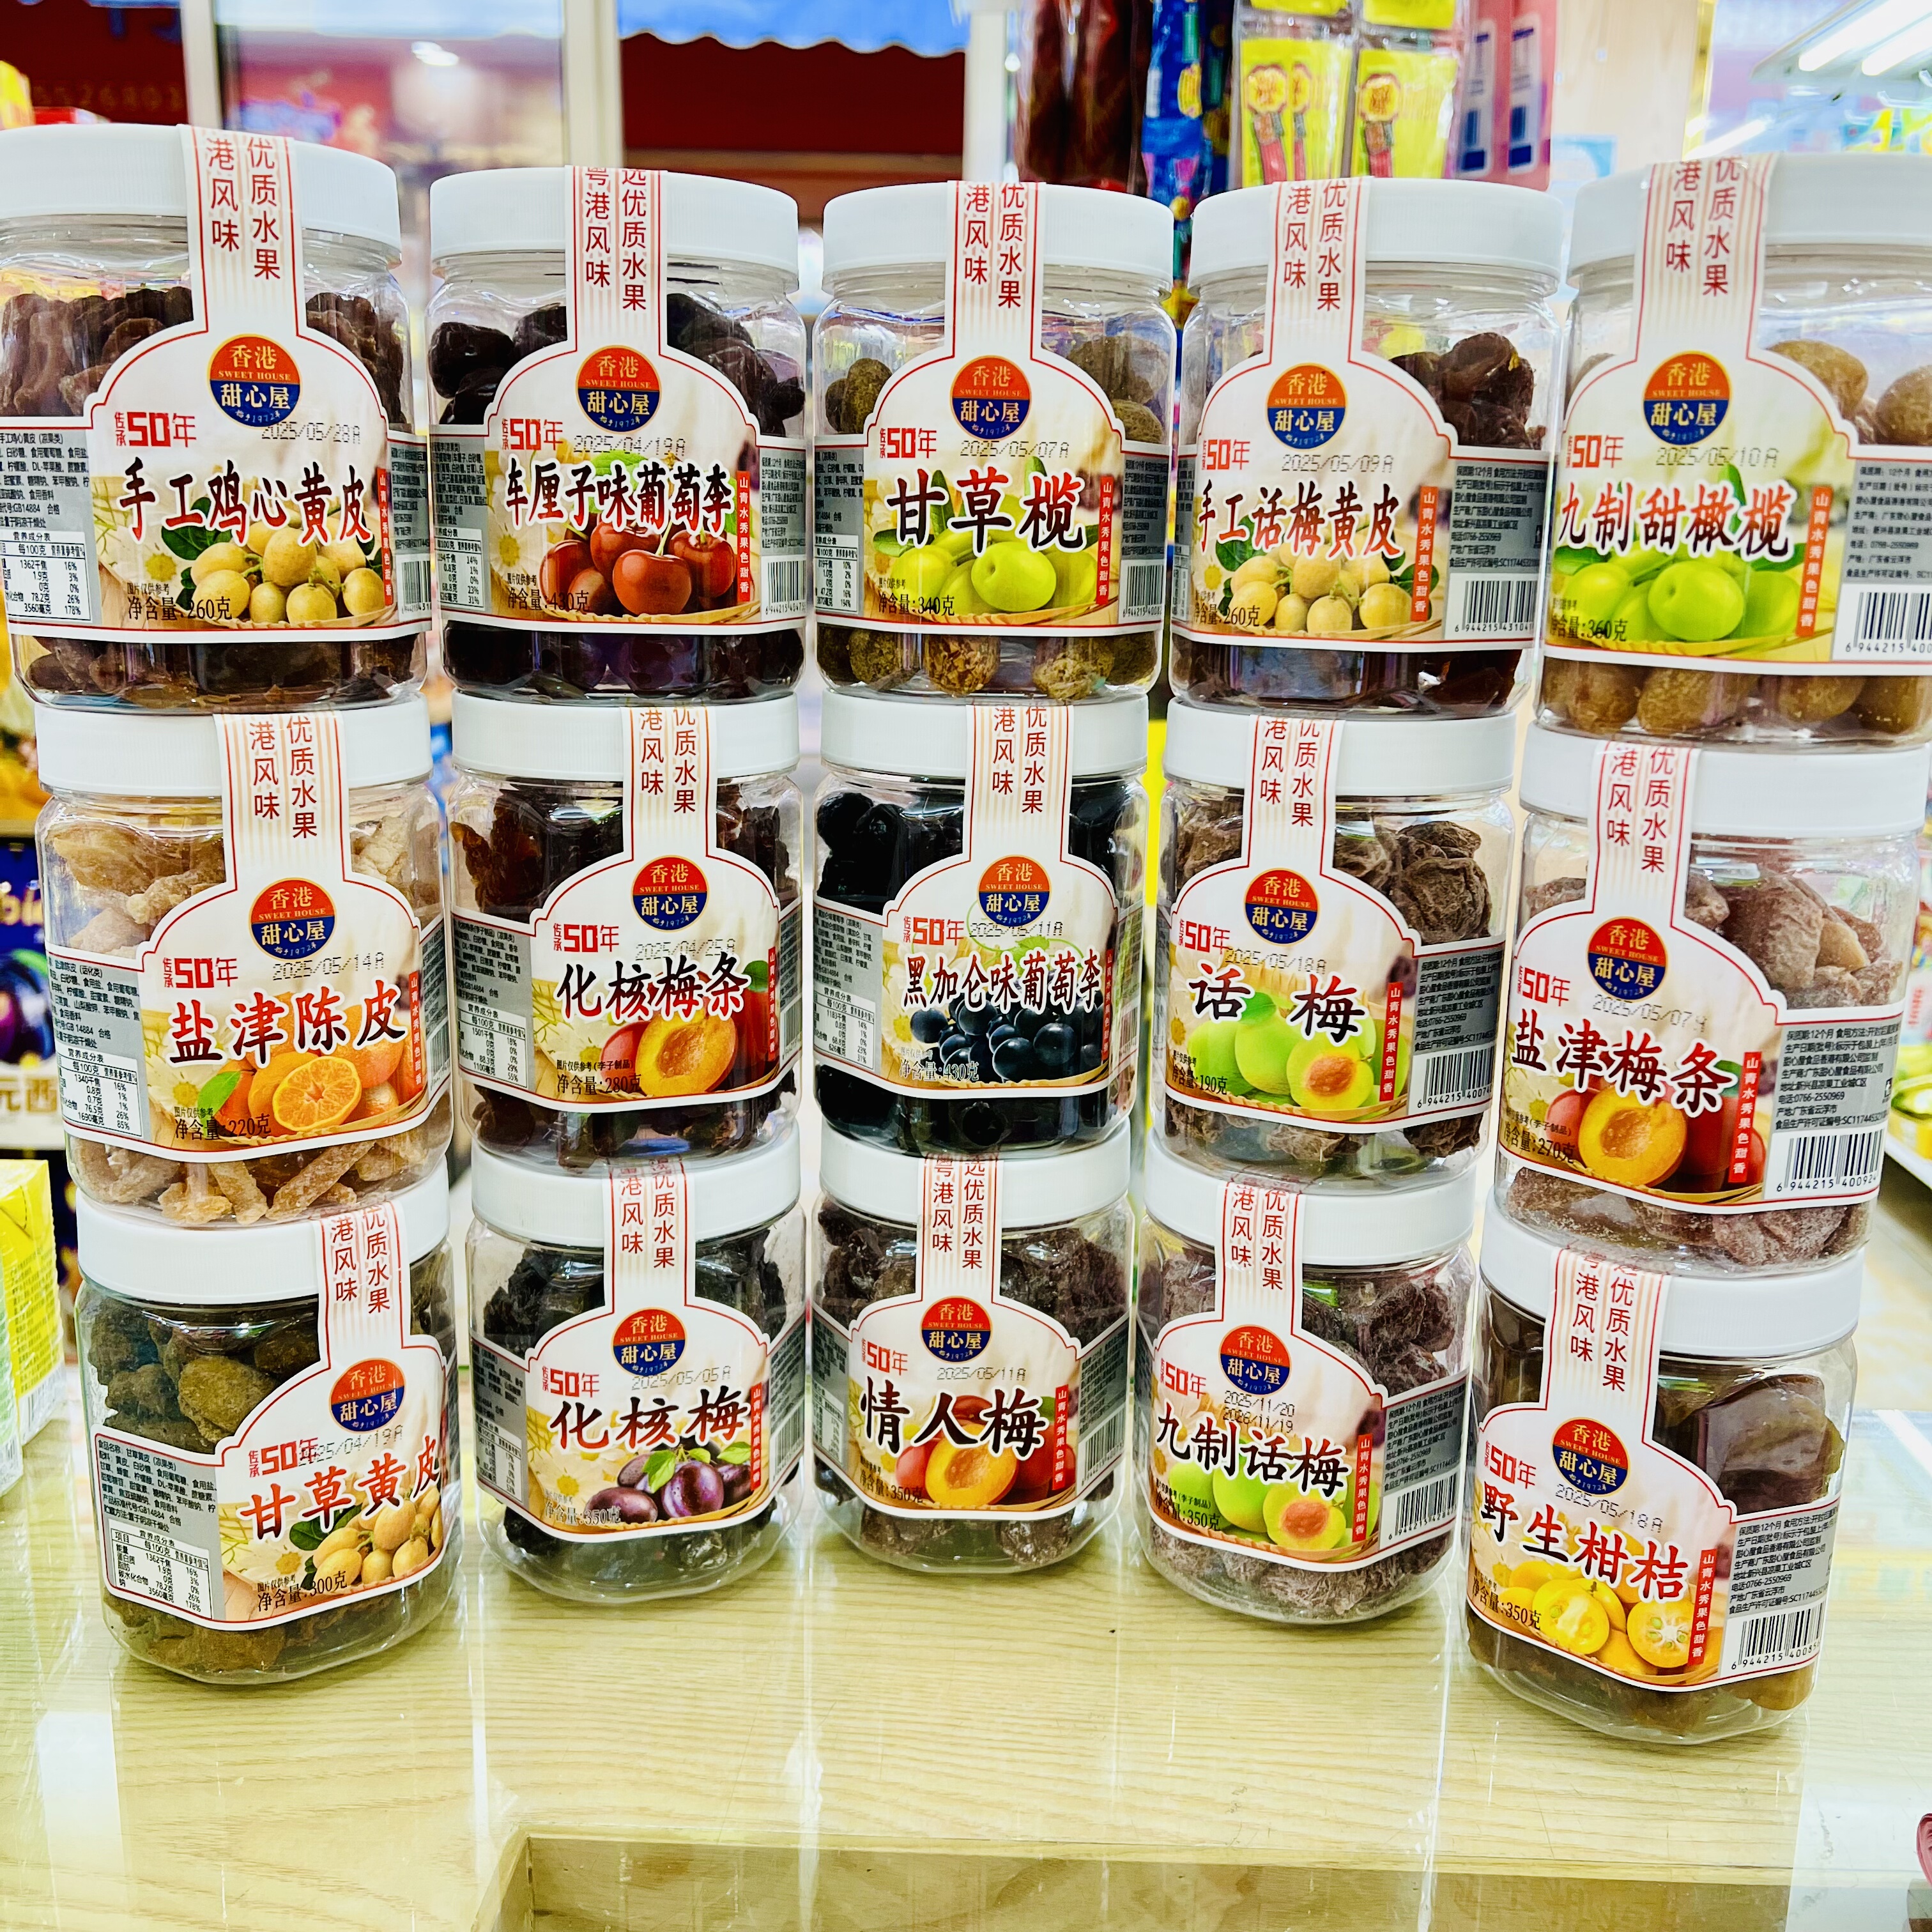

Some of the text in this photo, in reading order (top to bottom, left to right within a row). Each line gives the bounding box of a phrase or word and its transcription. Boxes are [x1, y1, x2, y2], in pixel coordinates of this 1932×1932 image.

[206, 138, 240, 252] 港风味
[247, 138, 281, 281] 优质水果
[965, 185, 990, 285] 港风味
[999, 183, 1025, 309] 优质水果
[1284, 187, 1312, 289] 港风味
[1317, 181, 1347, 312] 优质水果
[231, 344, 278, 369] 香港
[597, 356, 638, 378] 香港
[972, 365, 1012, 387] 香港
[1286, 374, 1328, 395] 香港
[1666, 363, 1710, 387] 香港
[220, 385, 291, 410] 甜心屋
[587, 392, 650, 415] 甜心屋
[960, 402, 1020, 423] 甜心屋
[1275, 410, 1335, 432] 甜心屋
[1651, 404, 1717, 427] 甜心屋
[119, 456, 373, 544] 手工鸡心黄皮
[507, 457, 732, 537] 车厘子味葡萄李
[887, 466, 1084, 553] 甘草榄
[1199, 479, 1400, 558] 手工话梅黄皮
[1558, 482, 1791, 556] 九制甜橄榄
[739, 477, 749, 594] 山青水秀果色甜香
[1099, 482, 1112, 596] 山青水秀果色甜香
[1414, 492, 1435, 612] 山青水秀果色甜香
[250, 722, 280, 820] 港风味
[287, 716, 318, 839] 优质水果
[992, 706, 1015, 795] 港风味
[1022, 704, 1047, 814] 优质水果
[1606, 747, 1637, 847] 港风味
[1641, 746, 1675, 873] 优质水果
[270, 886, 314, 909] 香港
[650, 864, 689, 884] 香港
[986, 894, 1041, 913] 甜心屋
[996, 863, 1033, 882] 香港
[1262, 877, 1301, 898] 香港
[259, 908, 326, 921] SWEET HOUSE
[261, 920, 326, 946] 甜心屋
[641, 896, 699, 916] 甜心屋
[1252, 907, 1308, 932] 甜心屋
[1607, 924, 1649, 950] 香港
[556, 951, 749, 1019] 化核梅条
[903, 948, 1100, 1011] 黑加仑味葡萄李
[1595, 958, 1655, 988] 甜心屋
[169, 979, 406, 1064] 盐津陈皮
[1383, 988, 1400, 1093] 山青水秀果色甜香
[1512, 1009, 1733, 1112] 盐津梅条
[1427, 1090, 1461, 1107] 944215
[1733, 1057, 1758, 1174] 山青水秀果色甜香
[1790, 1178, 1834, 1192] 944215
[331, 1216, 358, 1303] 港风味
[1231, 1186, 1255, 1268] 港风味
[1262, 1188, 1287, 1291] 优质水果
[363, 1206, 390, 1315] 优质水果
[631, 1315, 668, 1334] 香港
[929, 1332, 982, 1349] 甜心屋
[939, 1304, 974, 1321] 香港
[1238, 1331, 1273, 1354] 香港
[349, 1364, 386, 1390] 香港
[622, 1344, 677, 1363] 甜心屋
[1227, 1358, 1281, 1385] 甜心屋
[340, 1393, 397, 1423] 甜心屋
[550, 1385, 748, 1449] 化核梅
[861, 1376, 1047, 1457] 情人梅
[1055, 1390, 1067, 1482] 山青水秀果色甜香
[1573, 1424, 1611, 1452] 香港
[1157, 1402, 1349, 1498] 九制话梅
[1559, 1450, 1617, 1487] 甜心屋
[240, 1435, 440, 1540] 甘草黄皮
[1356, 1438, 1370, 1535] 山青水秀果色甜香
[1480, 1481, 1688, 1599] 野生柑桔
[1692, 1554, 1714, 1657] 山青水秀果色甜香
[1742, 1652, 1783, 1667] 944215
